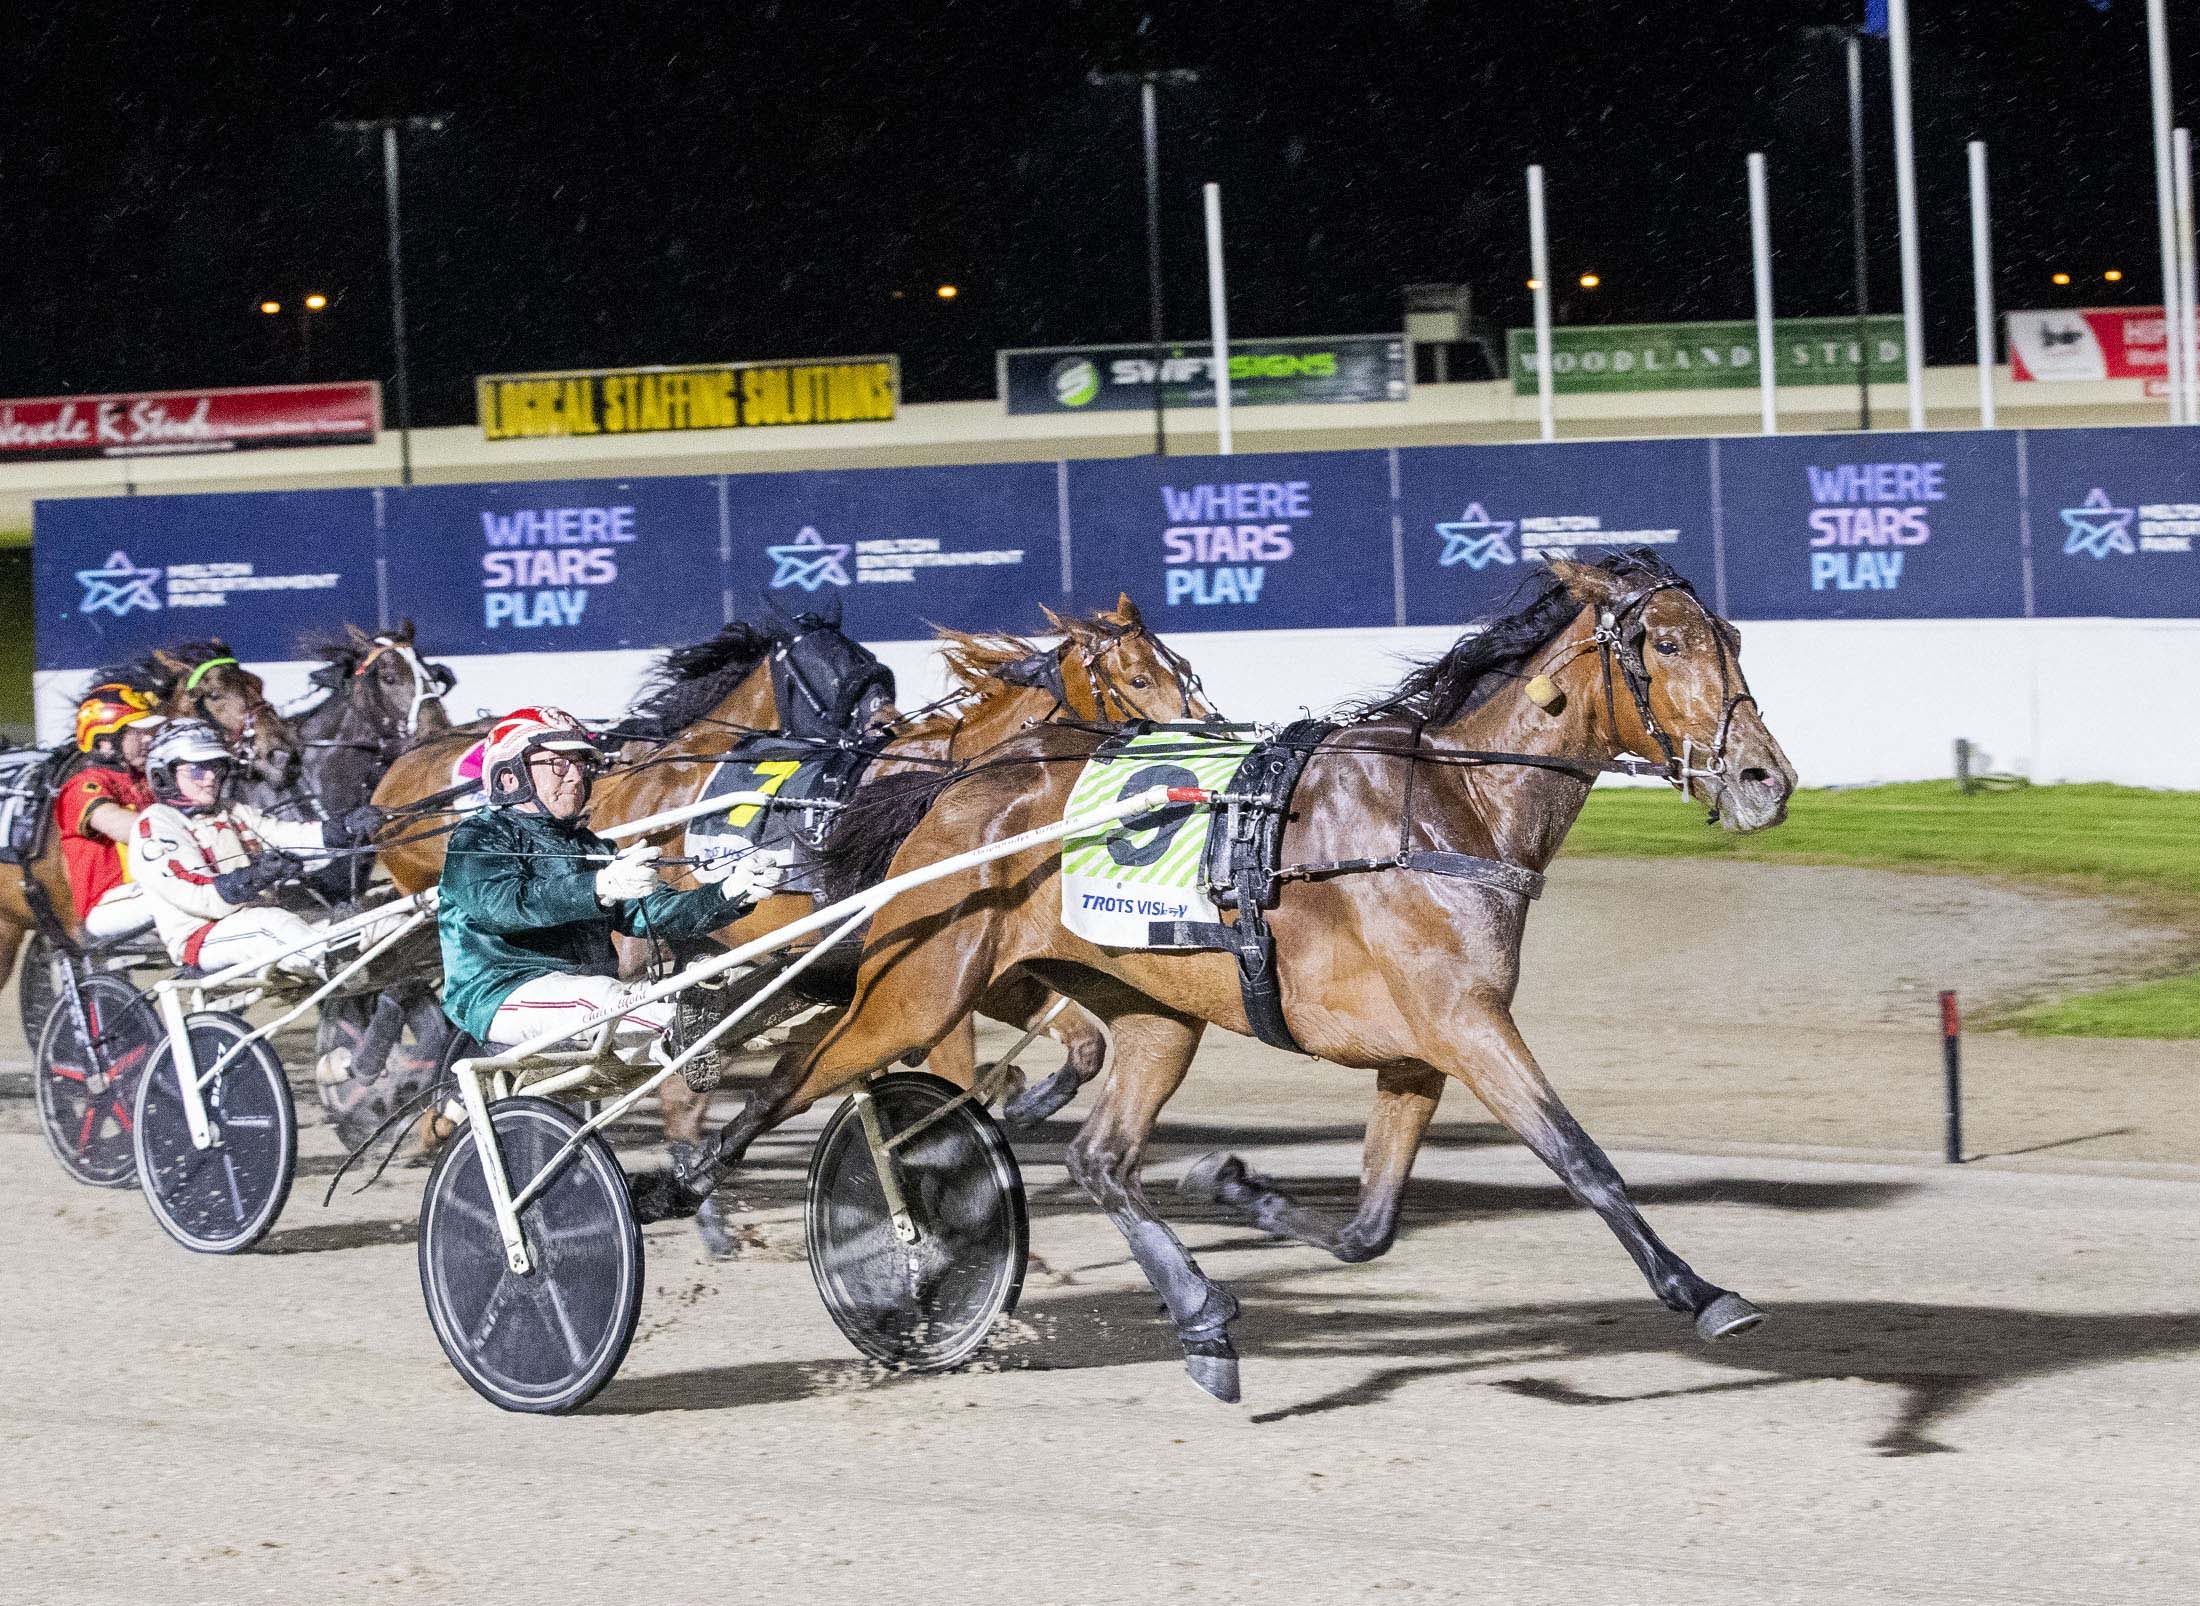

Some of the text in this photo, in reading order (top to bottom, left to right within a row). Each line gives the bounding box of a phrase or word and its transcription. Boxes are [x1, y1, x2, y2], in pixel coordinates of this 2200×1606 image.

[1520, 345, 1753, 374] WOODLAND
[1162, 481, 1310, 520] WHERE
[1807, 462, 1946, 502] WHERE
[482, 506, 636, 546] WHERE
[1163, 524, 1294, 563] STARS
[1808, 506, 1931, 548] STARS
[482, 548, 618, 587] STARS
[1166, 566, 1265, 606] PLAY
[1810, 551, 1904, 591] PLAY
[485, 590, 588, 629] PLAY
[727, 761, 802, 828] 7
[1106, 764, 1200, 867] 9
[1082, 894, 1134, 914] TROTS
